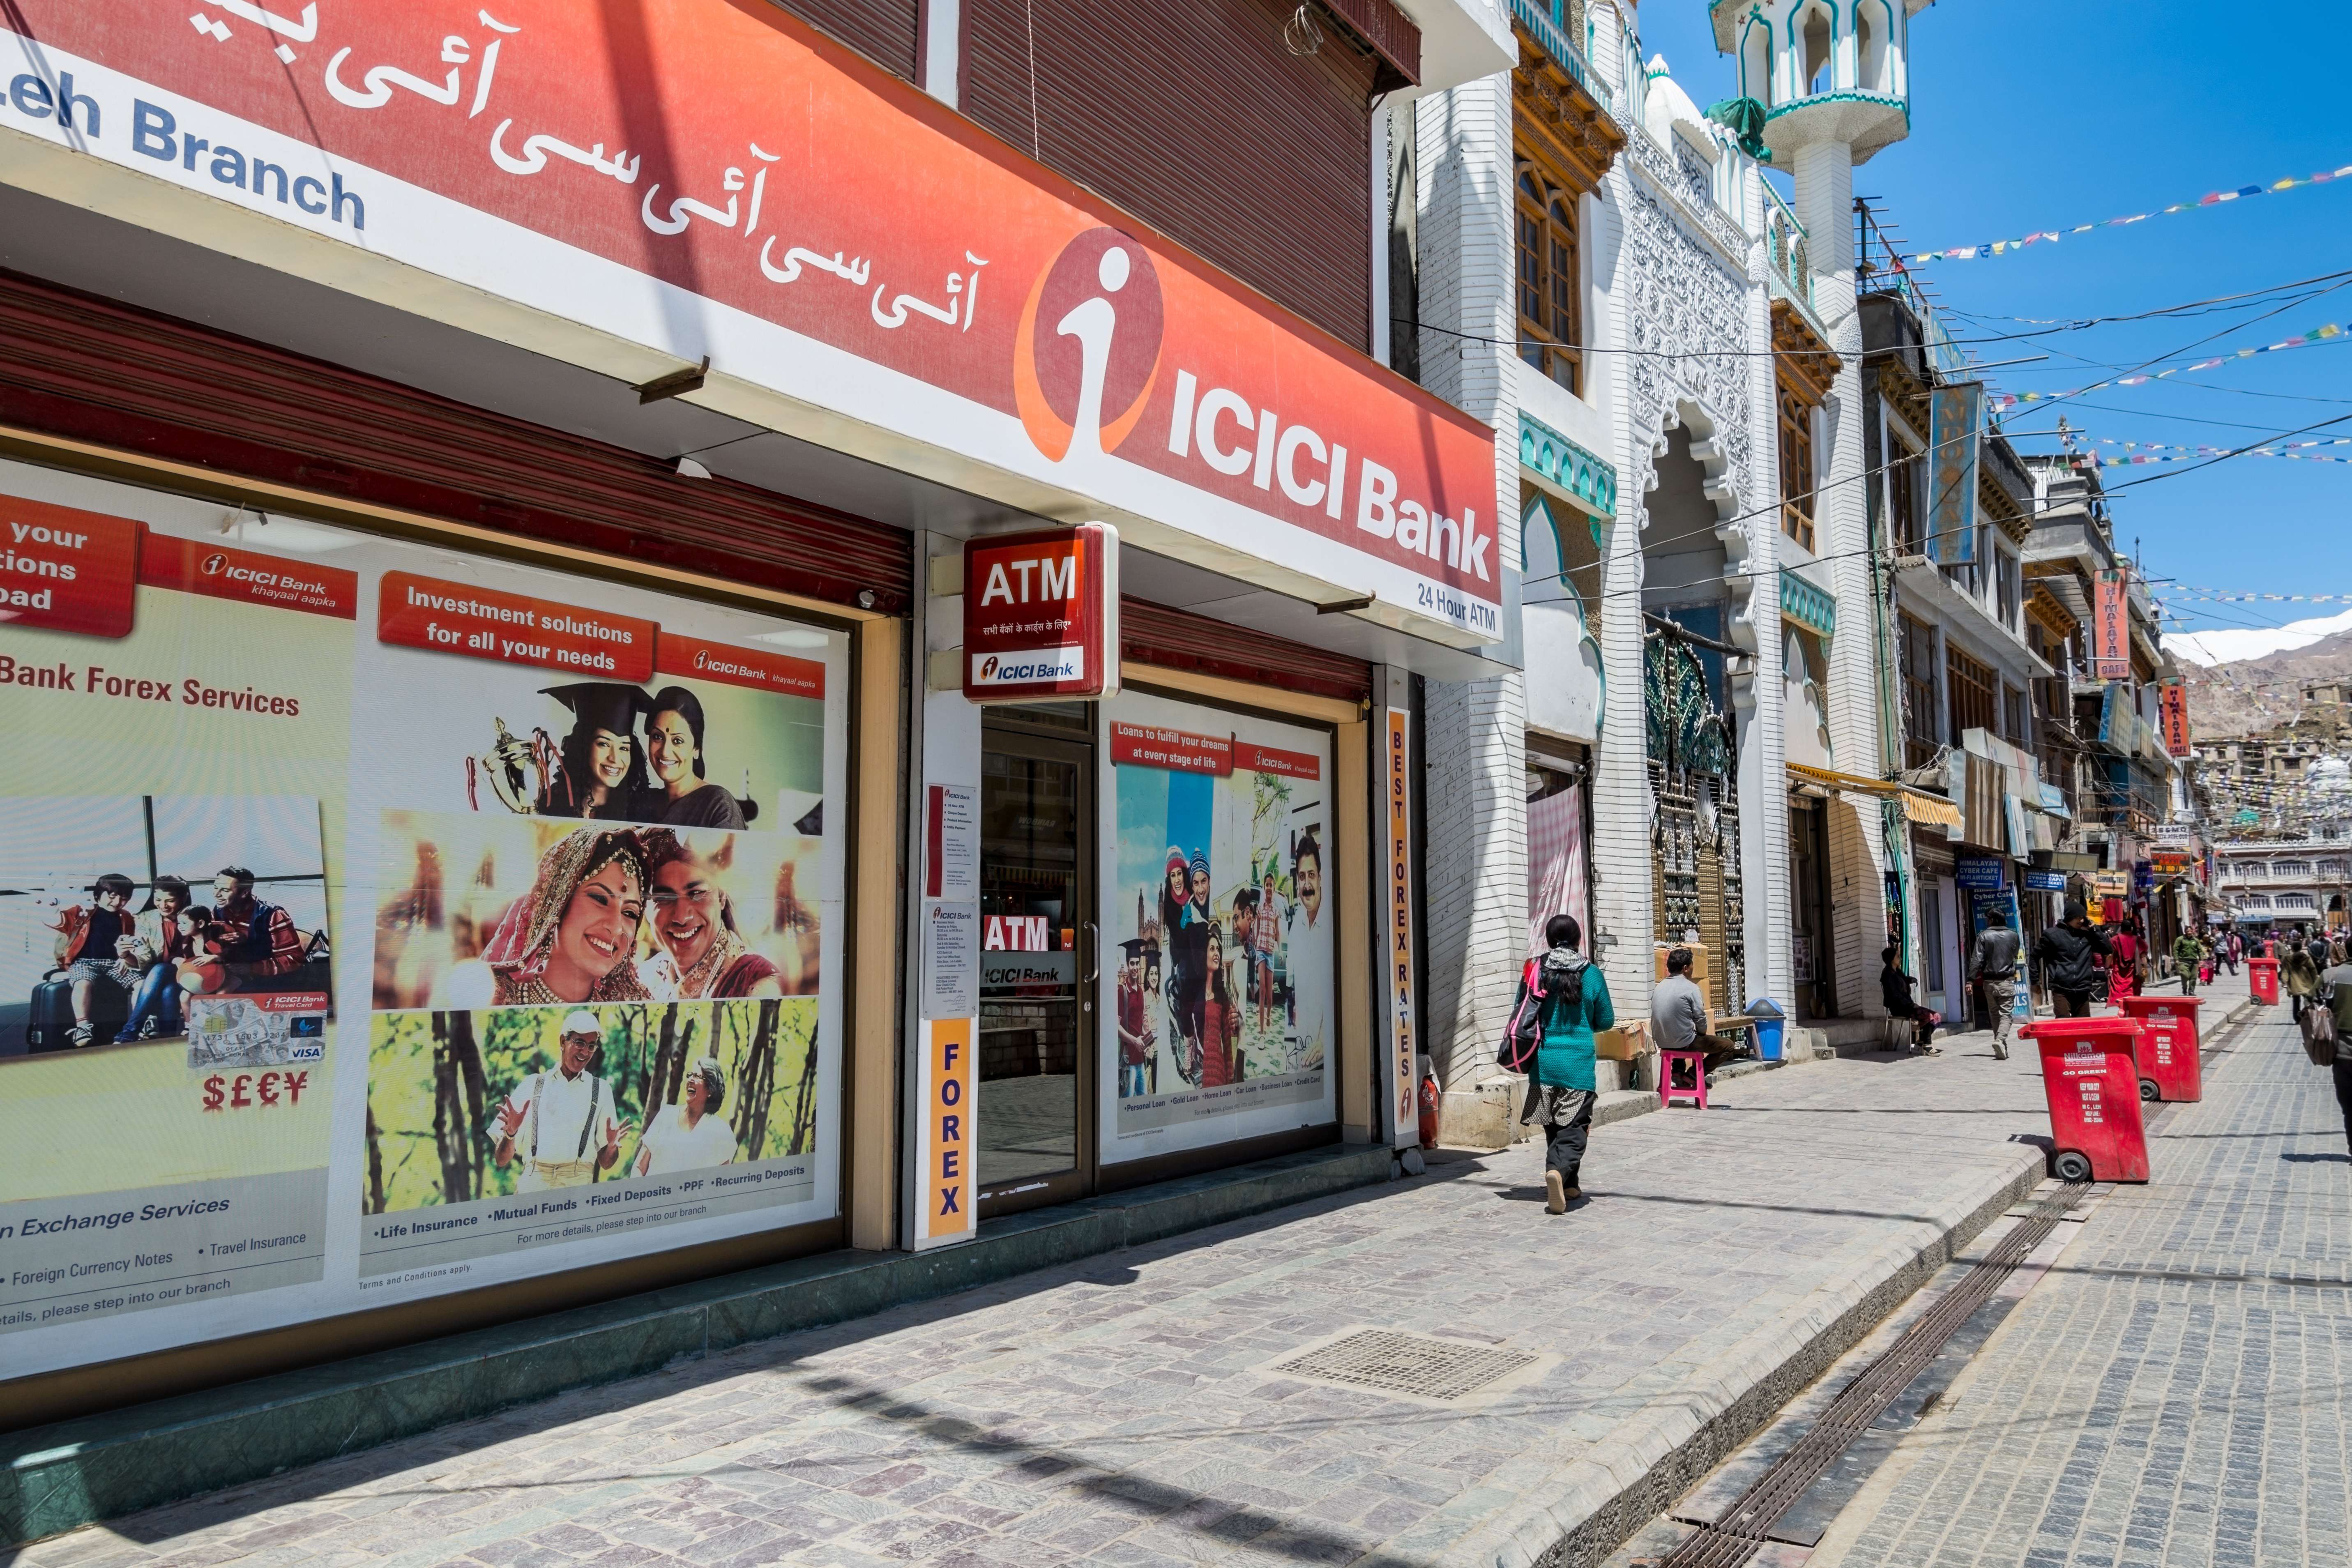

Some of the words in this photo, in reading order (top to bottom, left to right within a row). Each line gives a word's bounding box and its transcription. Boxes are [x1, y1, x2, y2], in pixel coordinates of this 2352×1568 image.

[325, 9, 521, 119] آئی
[132, 98, 365, 231] Branch
[491, 118, 640, 183] سی
[641, 143, 781, 237] آئی
[760, 235, 870, 286] سی
[871, 250, 989, 333] آئی
[1168, 369, 1348, 521] ICICI
[1357, 457, 1491, 583] Bank
[11, 522, 88, 549] your
[226, 566, 277, 586] ICICI
[280, 576, 327, 595] Bank
[251, 585, 299, 601] khayaal
[301, 594, 336, 608] aapka
[981, 556, 1075, 607] ATM
[408, 586, 535, 627] Investment
[541, 615, 633, 644] solutions
[983, 624, 997, 635] सभी
[1000, 623, 1014, 634] बैंकों
[1016, 622, 1023, 633] के
[1046, 620, 1052, 630] के
[1418, 583, 1433, 608] 24
[1437, 589, 1466, 620] Hour
[1470, 603, 1495, 631] ATM
[426, 623, 462, 644] for
[468, 631, 495, 651] all
[502, 638, 550, 660] your
[557, 648, 616, 670] needs
[0, 656, 76, 691] Bank
[87, 667, 172, 702] Forex
[182, 679, 299, 716] Services
[707, 660, 737, 675] ICICI
[739, 666, 766, 679] Bank
[772, 675, 796, 684] khayaal
[797, 679, 815, 688] aapka
[997, 665, 1034, 680] ICICI
[1037, 663, 1073, 677] Bank
[1118, 723, 1143, 738] Loans
[1146, 729, 1154, 739] to
[1157, 730, 1179, 743] fulfill
[1181, 736, 1198, 746] your
[1201, 737, 1229, 751] dreams
[1133, 748, 1142, 758] at
[1145, 750, 1167, 763] every
[1170, 753, 1191, 767] stage
[1193, 756, 1202, 766] of
[1204, 757, 1216, 768] life
[1262, 758, 1277, 768] ICICI
[1278, 761, 1291, 770] Bank
[1393, 730, 1403, 819] BEST
[1396, 840, 1406, 951] FOREX
[985, 916, 1048, 951] ATM
[1023, 968, 1059, 982] Bank
[1398, 967, 1410, 1078] RATES
[293, 1048, 320, 1058] VISA
[1127, 1101, 1150, 1112] Personal
[1205, 1091, 1219, 1099] Home
[941, 1043, 961, 1216] FOREX
[21, 1209, 135, 1236] Exchange
[140, 1198, 230, 1221] Services
[381, 1225, 407, 1239] Life
[412, 1216, 478, 1234] Insurance
[493, 1205, 537, 1221] Mutual
[542, 1199, 577, 1214] Funds
[591, 1193, 621, 1206] Fixed
[625, 1186, 671, 1202] Deposits
[684, 1180, 704, 1191] PPF
[715, 1173, 762, 1187] Recurring
[765, 1166, 805, 1180] Deposits
[518, 1234, 532, 1244] For
[535, 1231, 560, 1241] more
[562, 1224, 594, 1237] details,
[596, 1219, 624, 1232] please
[626, 1216, 644, 1227] step
[646, 1213, 661, 1223] into
[664, 1210, 677, 1220] our
[680, 1205, 707, 1216] branch
[13, 1267, 65, 1285] Foreign
[70, 1259, 130, 1277] Currency
[135, 1252, 173, 1268] Notes
[210, 1239, 247, 1257] Travel
[250, 1233, 306, 1250] Insurance
[359, 1279, 383, 1290] Terms
[387, 1276, 401, 1285] and
[405, 1268, 447, 1282] Conditions
[450, 1264, 472, 1274] apply.
[42, 1302, 90, 1321] please
[93, 1297, 124, 1311] step
[128, 1290, 154, 1305] into
[158, 1288, 182, 1300] our
[186, 1278, 231, 1296] branch
